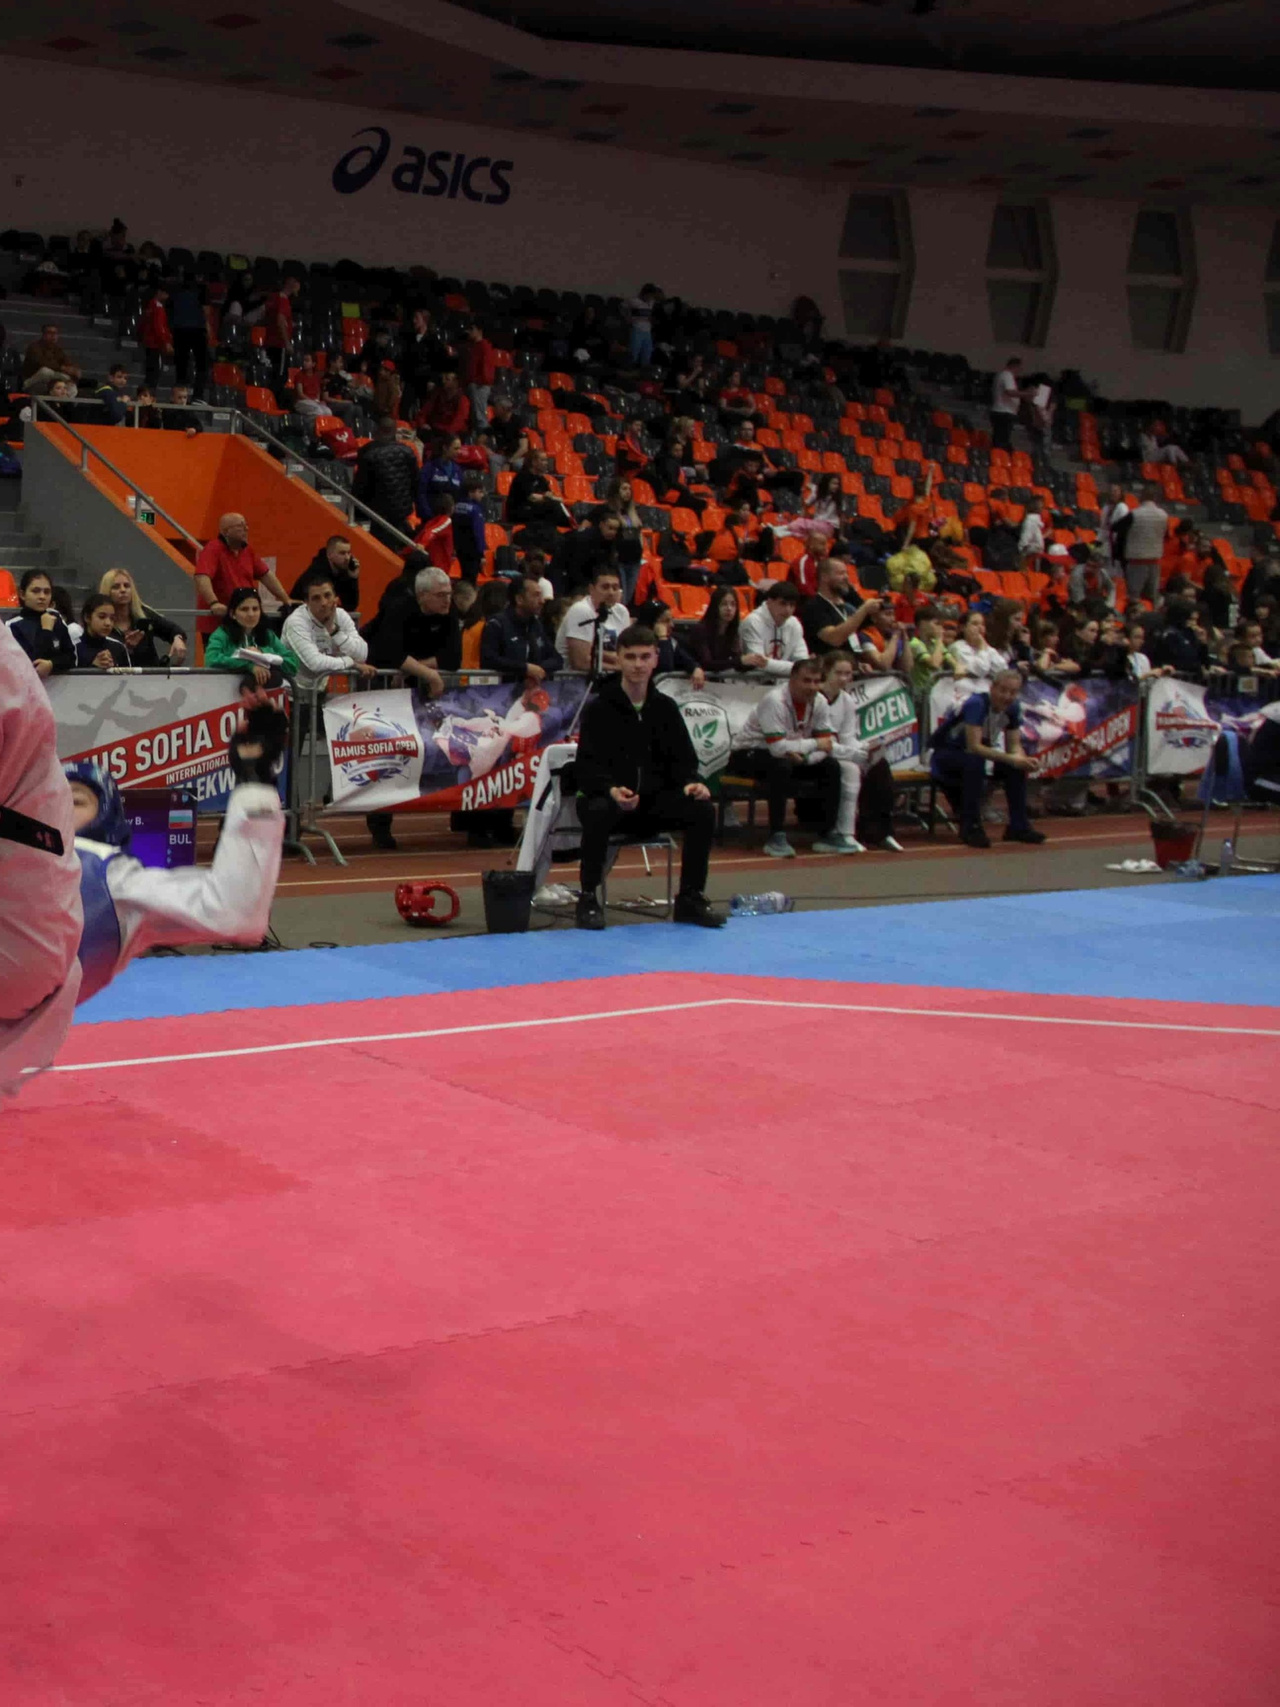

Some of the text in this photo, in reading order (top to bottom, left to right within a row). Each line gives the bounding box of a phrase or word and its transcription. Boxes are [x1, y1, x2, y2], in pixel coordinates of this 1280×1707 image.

[391, 145, 514, 205] asics
[864, 692, 910, 732] OPEN
[135, 719, 213, 771] SOFIA
[334, 739, 417, 758] RAMUS SOFIA OPEN
[165, 754, 230, 786] INTERNATIONAL
[461, 761, 525, 812] RAMUS
[169, 834, 192, 845] BUL
